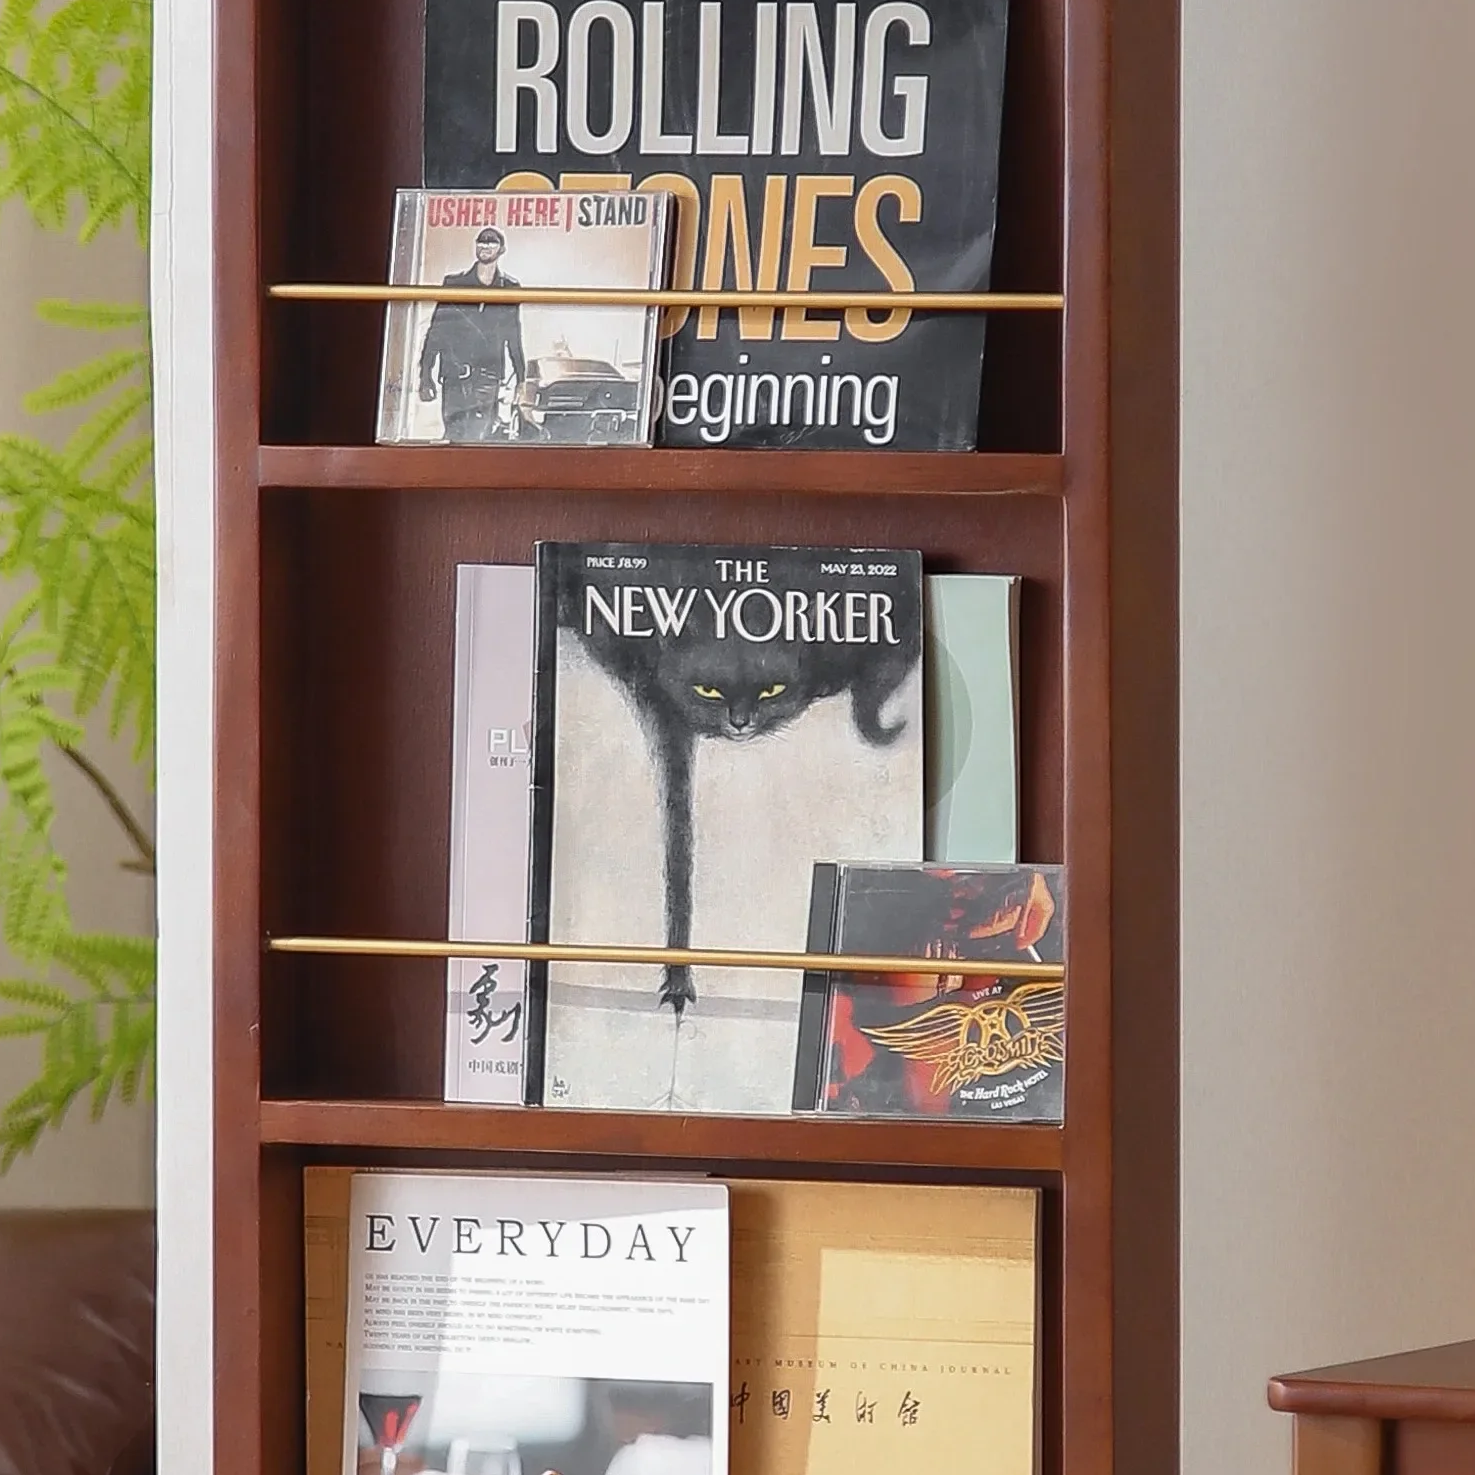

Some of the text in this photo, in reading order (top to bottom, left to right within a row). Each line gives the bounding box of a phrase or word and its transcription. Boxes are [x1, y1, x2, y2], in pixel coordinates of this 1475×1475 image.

[494, 0, 931, 156] ROLLING
[428, 197, 497, 227] USHER
[507, 197, 560, 227] HERE
[578, 196, 647, 227] STAND
[493, 172, 922, 342] ONES
[652, 354, 898, 444] eginning
[586, 556, 648, 569] PRICE $8.99
[715, 560, 770, 583] THE
[821, 563, 897, 575] MAY 23, 2022
[585, 585, 901, 644] NEW YORKER
[972, 986, 1003, 1001] LIVE AT
[468, 1059, 524, 1075] 中国戏剧
[974, 1086, 999, 1100] Hard
[1000, 1080, 1024, 1098] Rock
[365, 1215, 696, 1262] EVERYDAY
[775, 1360, 838, 1369] MUSEUM
[850, 1362, 867, 1370] OF
[879, 1363, 929, 1372] CHINA
[941, 1365, 1012, 1375] JOURNAL
